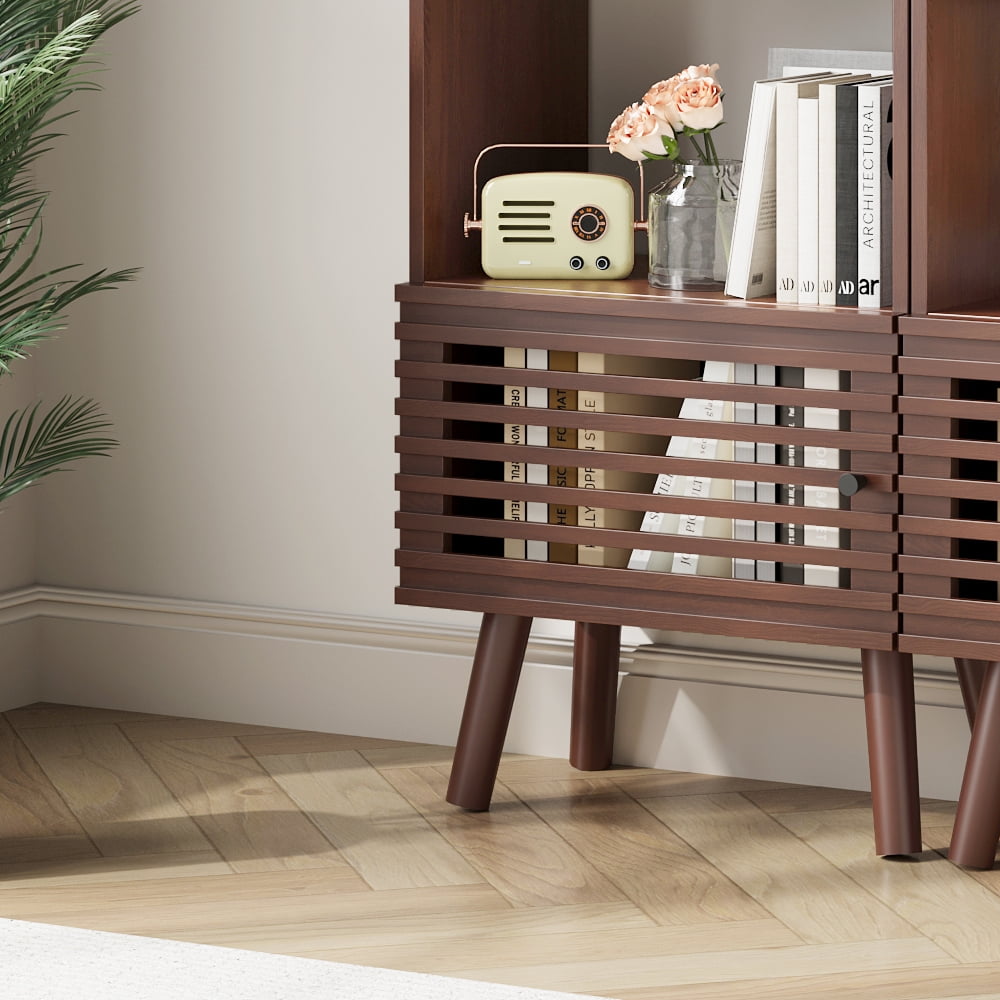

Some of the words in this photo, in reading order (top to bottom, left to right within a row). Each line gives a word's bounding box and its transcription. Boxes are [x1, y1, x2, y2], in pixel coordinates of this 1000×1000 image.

[862, 100, 874, 249] ARCHITECTURAL
[779, 277, 795, 291] AD
[800, 280, 815, 293] AD
[820, 280, 833, 293] AD
[838, 280, 856, 295] AD
[858, 278, 880, 296] ar
